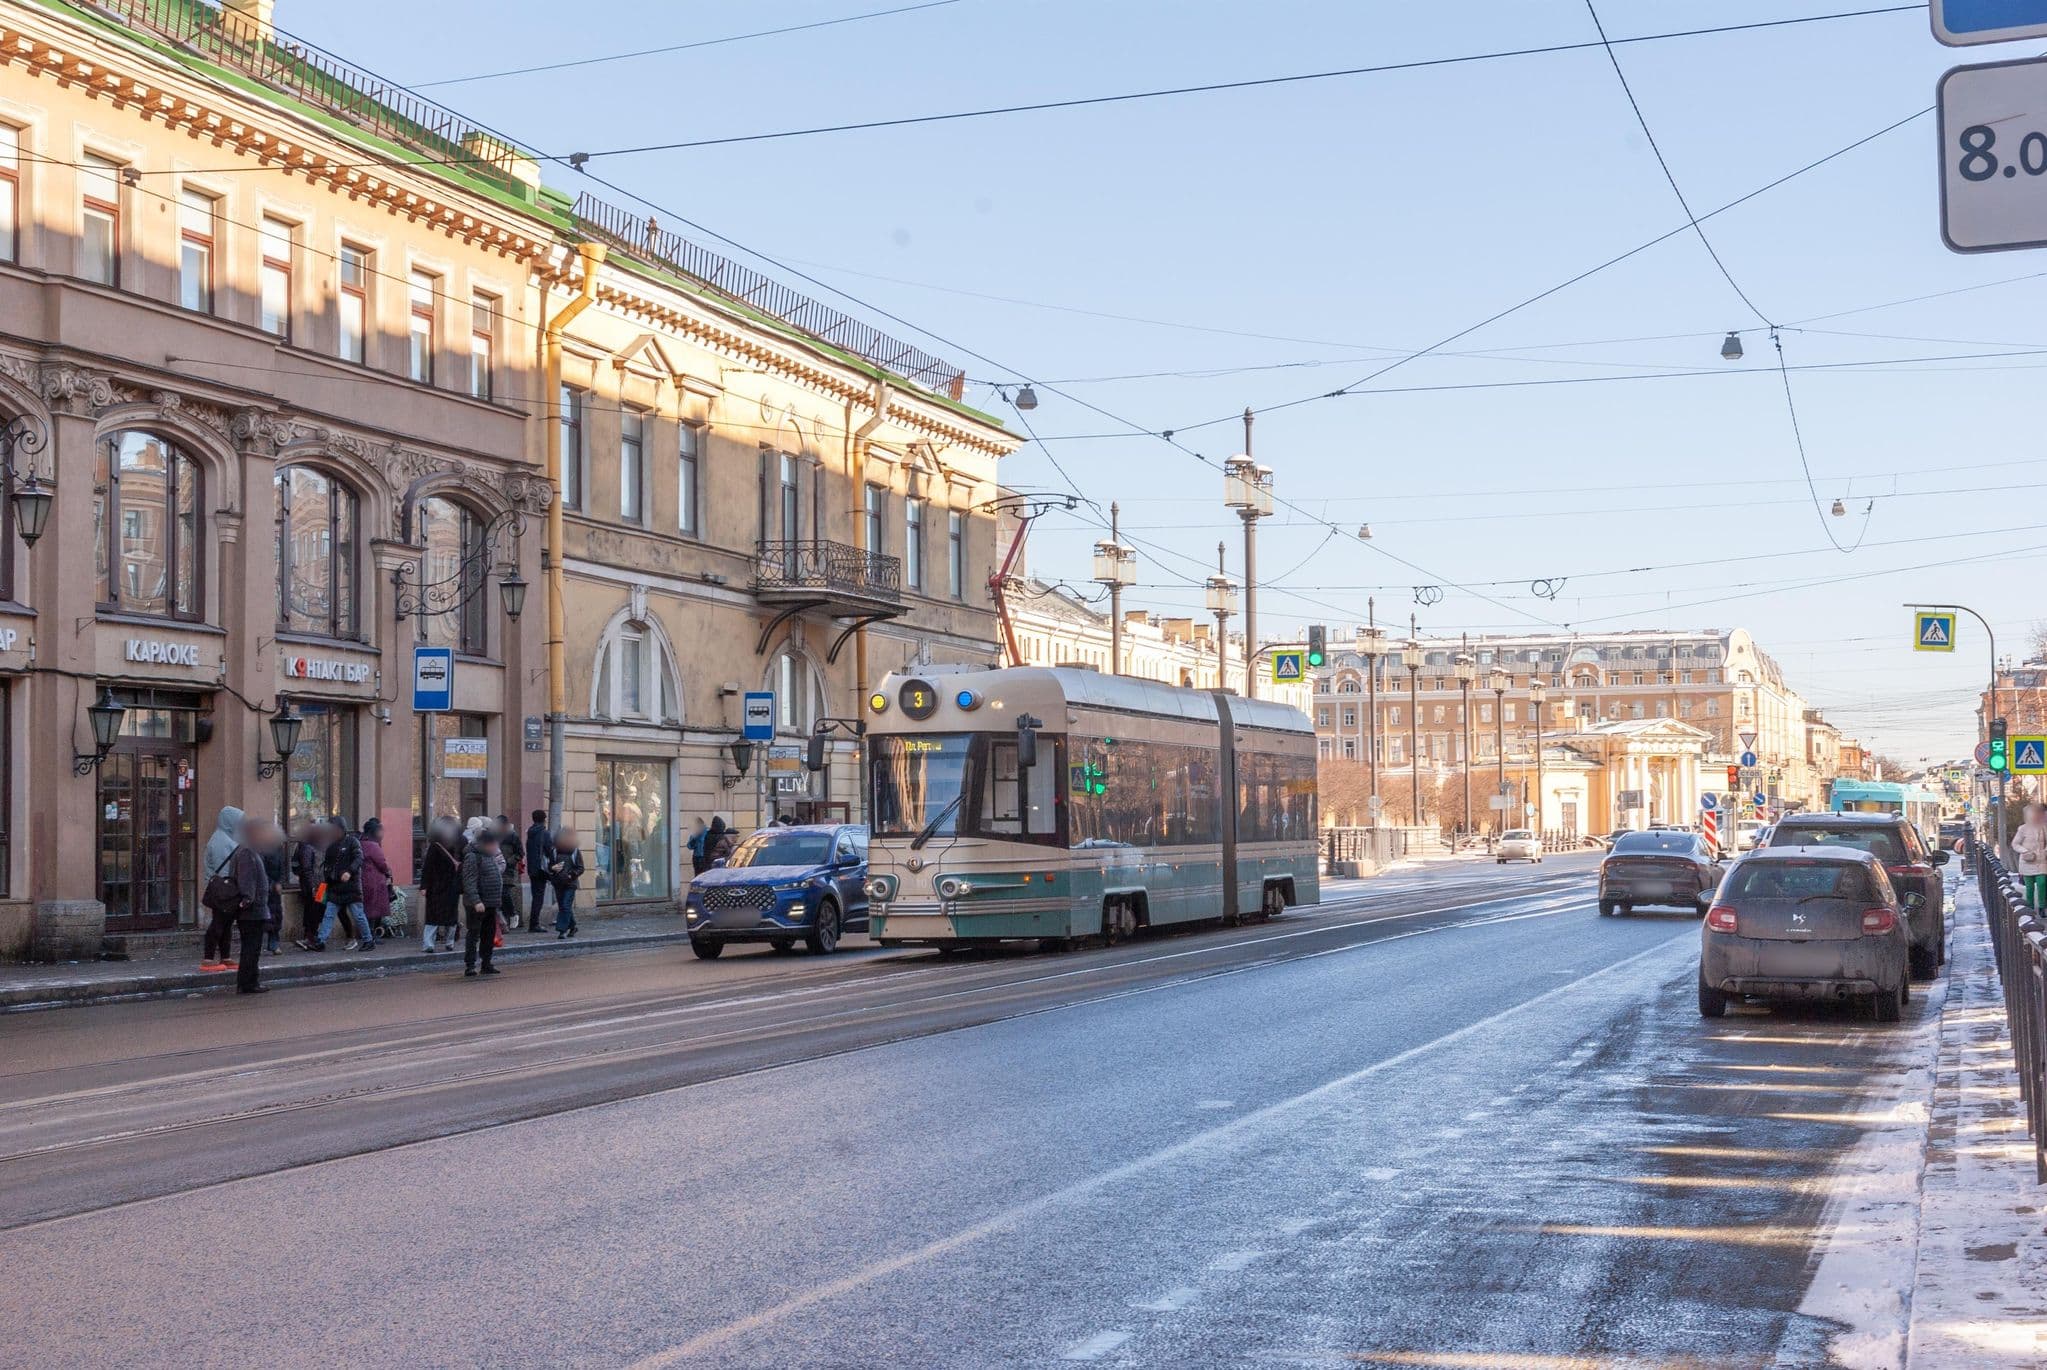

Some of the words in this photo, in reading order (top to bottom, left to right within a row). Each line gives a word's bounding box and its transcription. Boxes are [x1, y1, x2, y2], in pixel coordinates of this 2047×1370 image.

[126, 639, 199, 666] КАРАОКЕ
[288, 656, 344, 680] КОНТАКТ
[346, 663, 369, 682] БАР
[914, 691, 923, 708] 3
